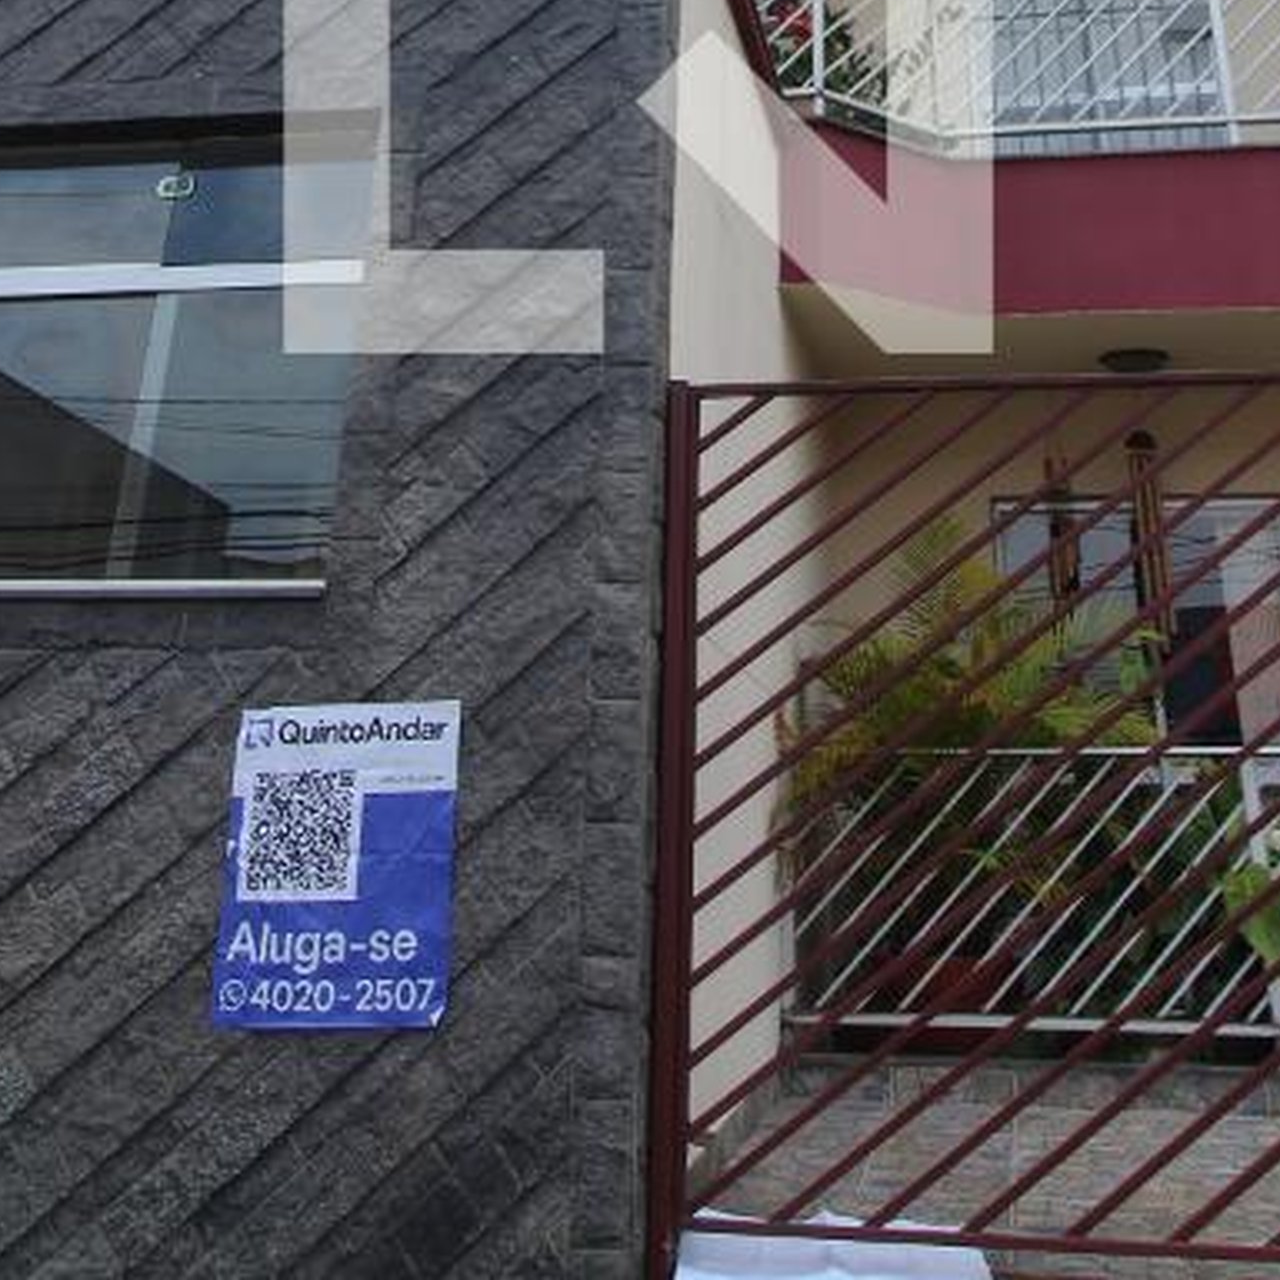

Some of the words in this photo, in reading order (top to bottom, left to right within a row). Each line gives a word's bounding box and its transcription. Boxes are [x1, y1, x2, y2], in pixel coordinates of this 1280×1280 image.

[278, 716, 449, 745] QuintoAndar
[227, 922, 418, 974] Aluga-se
[251, 979, 435, 1011] 4020-2507
